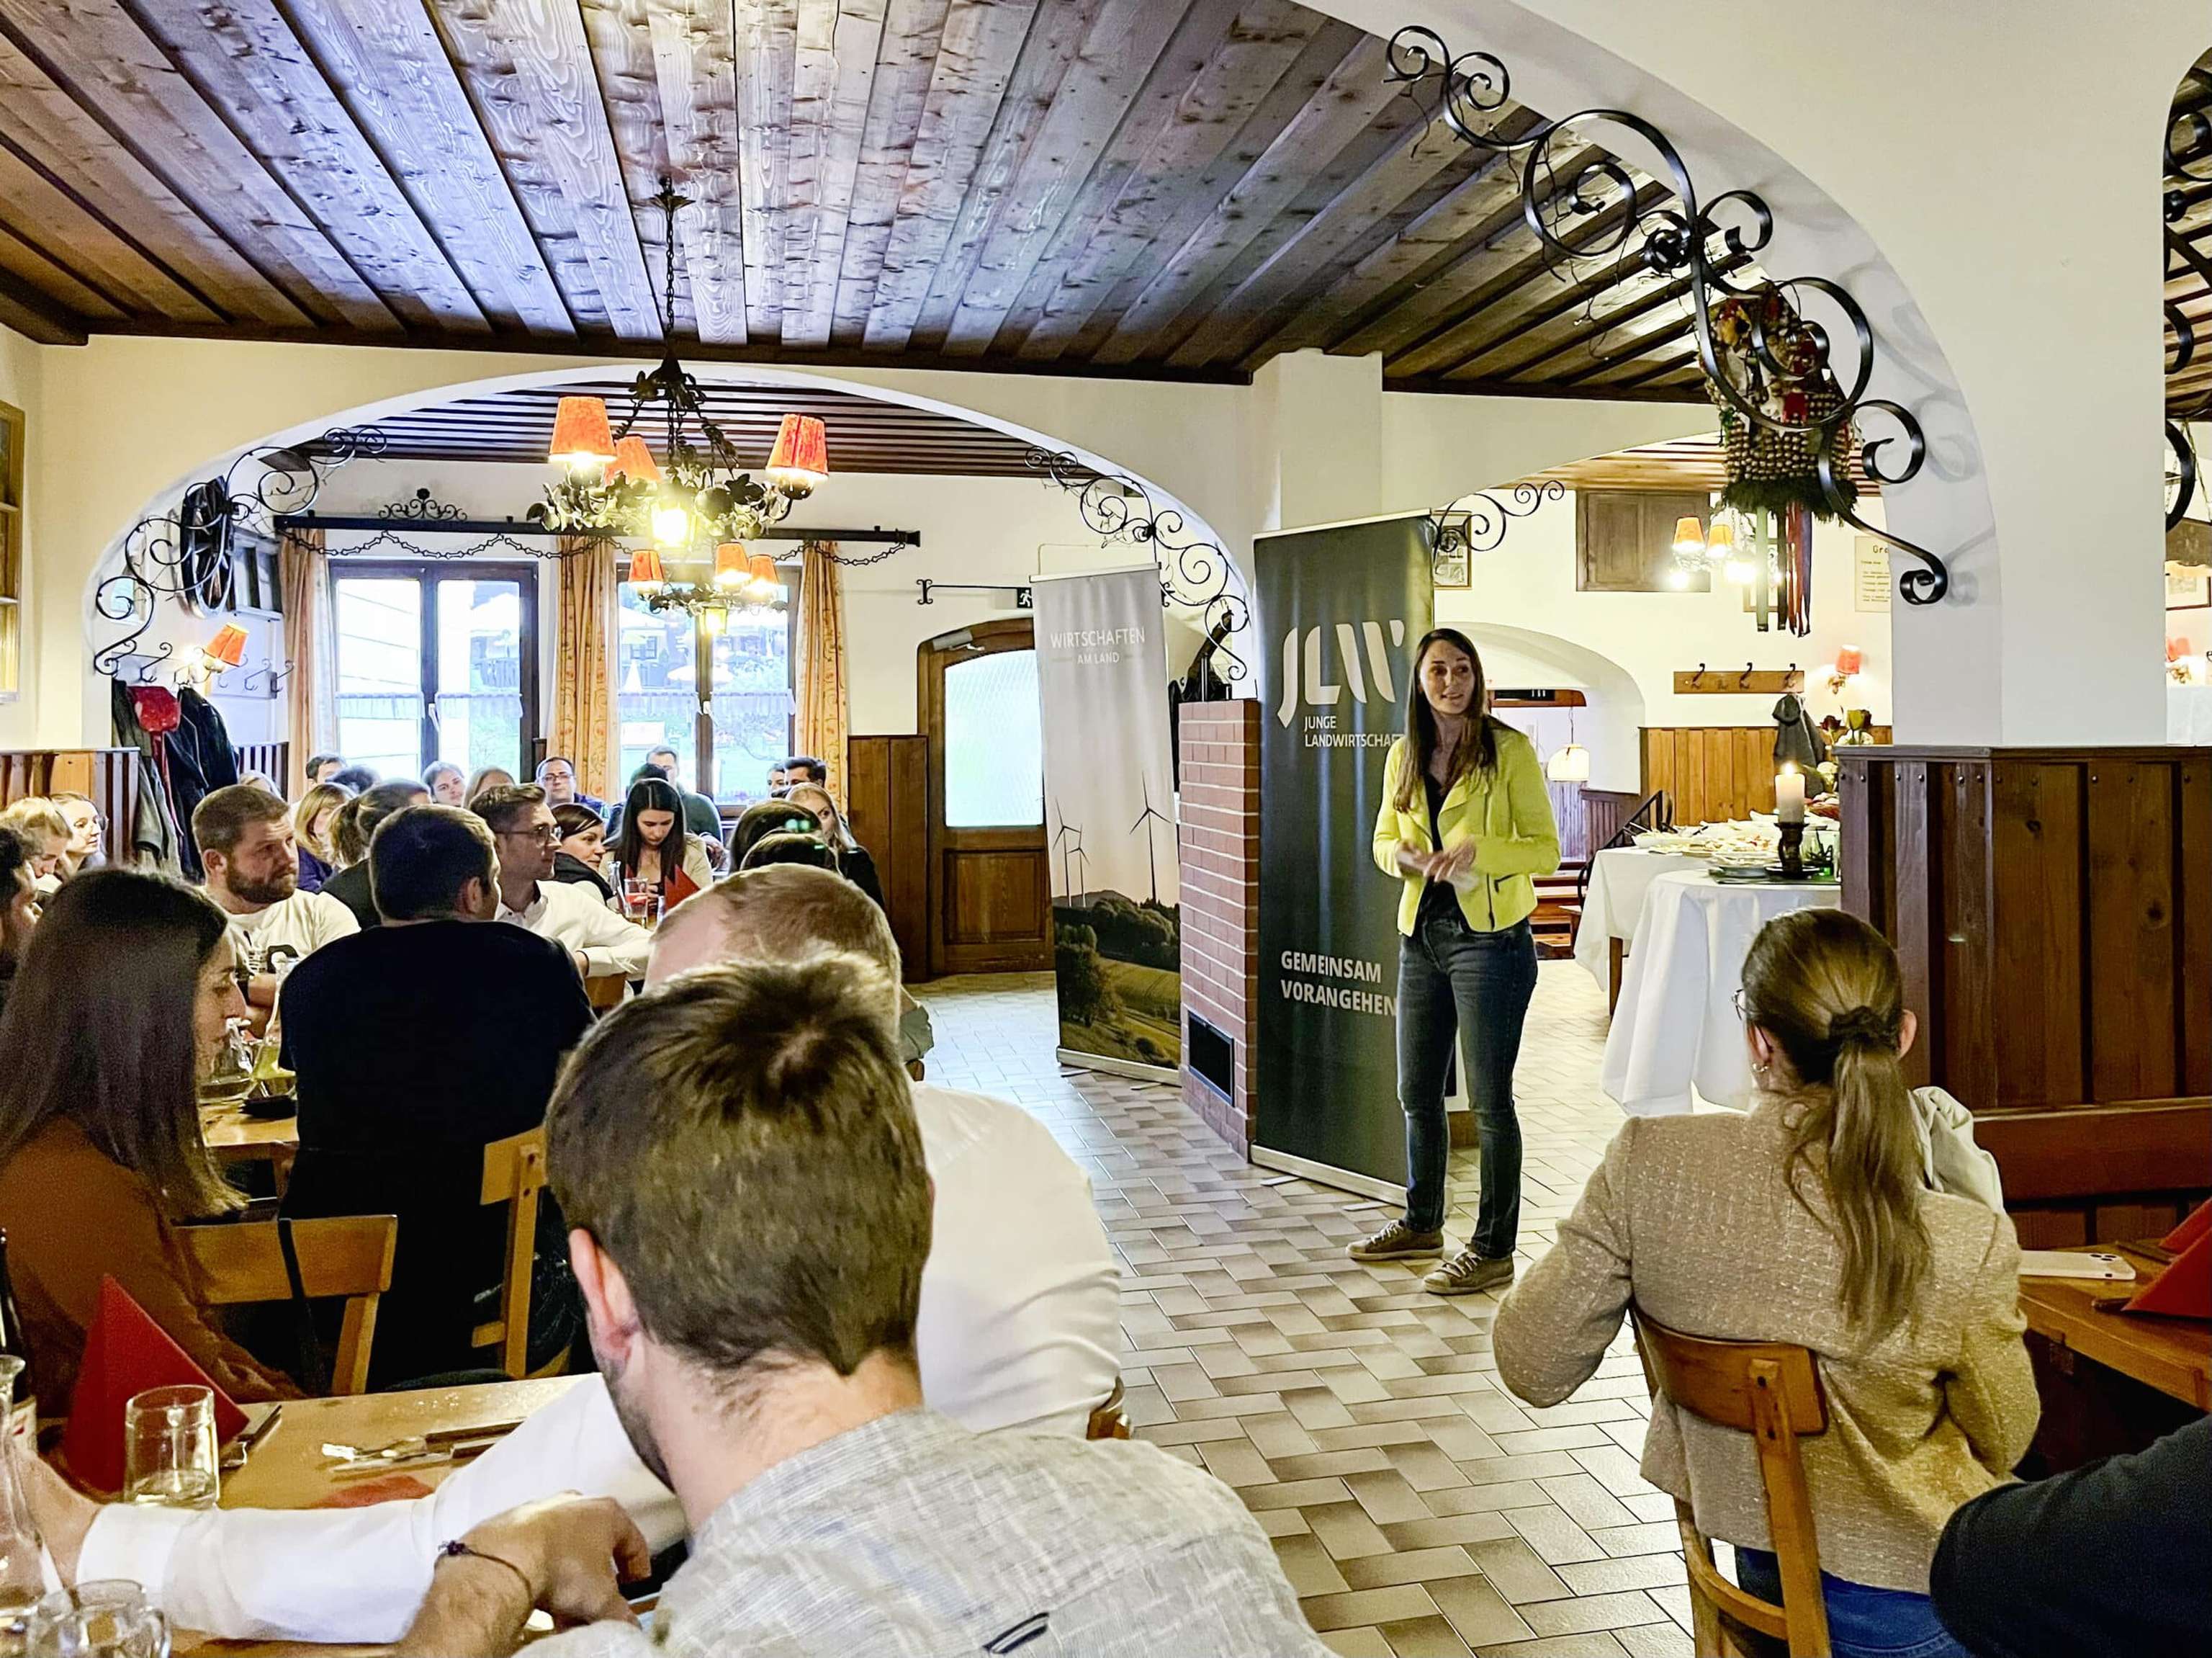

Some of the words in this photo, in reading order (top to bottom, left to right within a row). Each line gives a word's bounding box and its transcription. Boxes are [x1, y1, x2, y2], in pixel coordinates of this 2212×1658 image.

[1050, 627, 1145, 648] WIRTSCHAFTEN
[1077, 653, 1092, 665] AM
[1094, 651, 1120, 665] LAND
[1304, 715, 1337, 732] JUNGE
[1305, 733, 1405, 748] LANDWIRTSCHAF
[1281, 950, 1382, 984] GEMEINSAM
[1280, 979, 1398, 1017] VORANGEHEN
